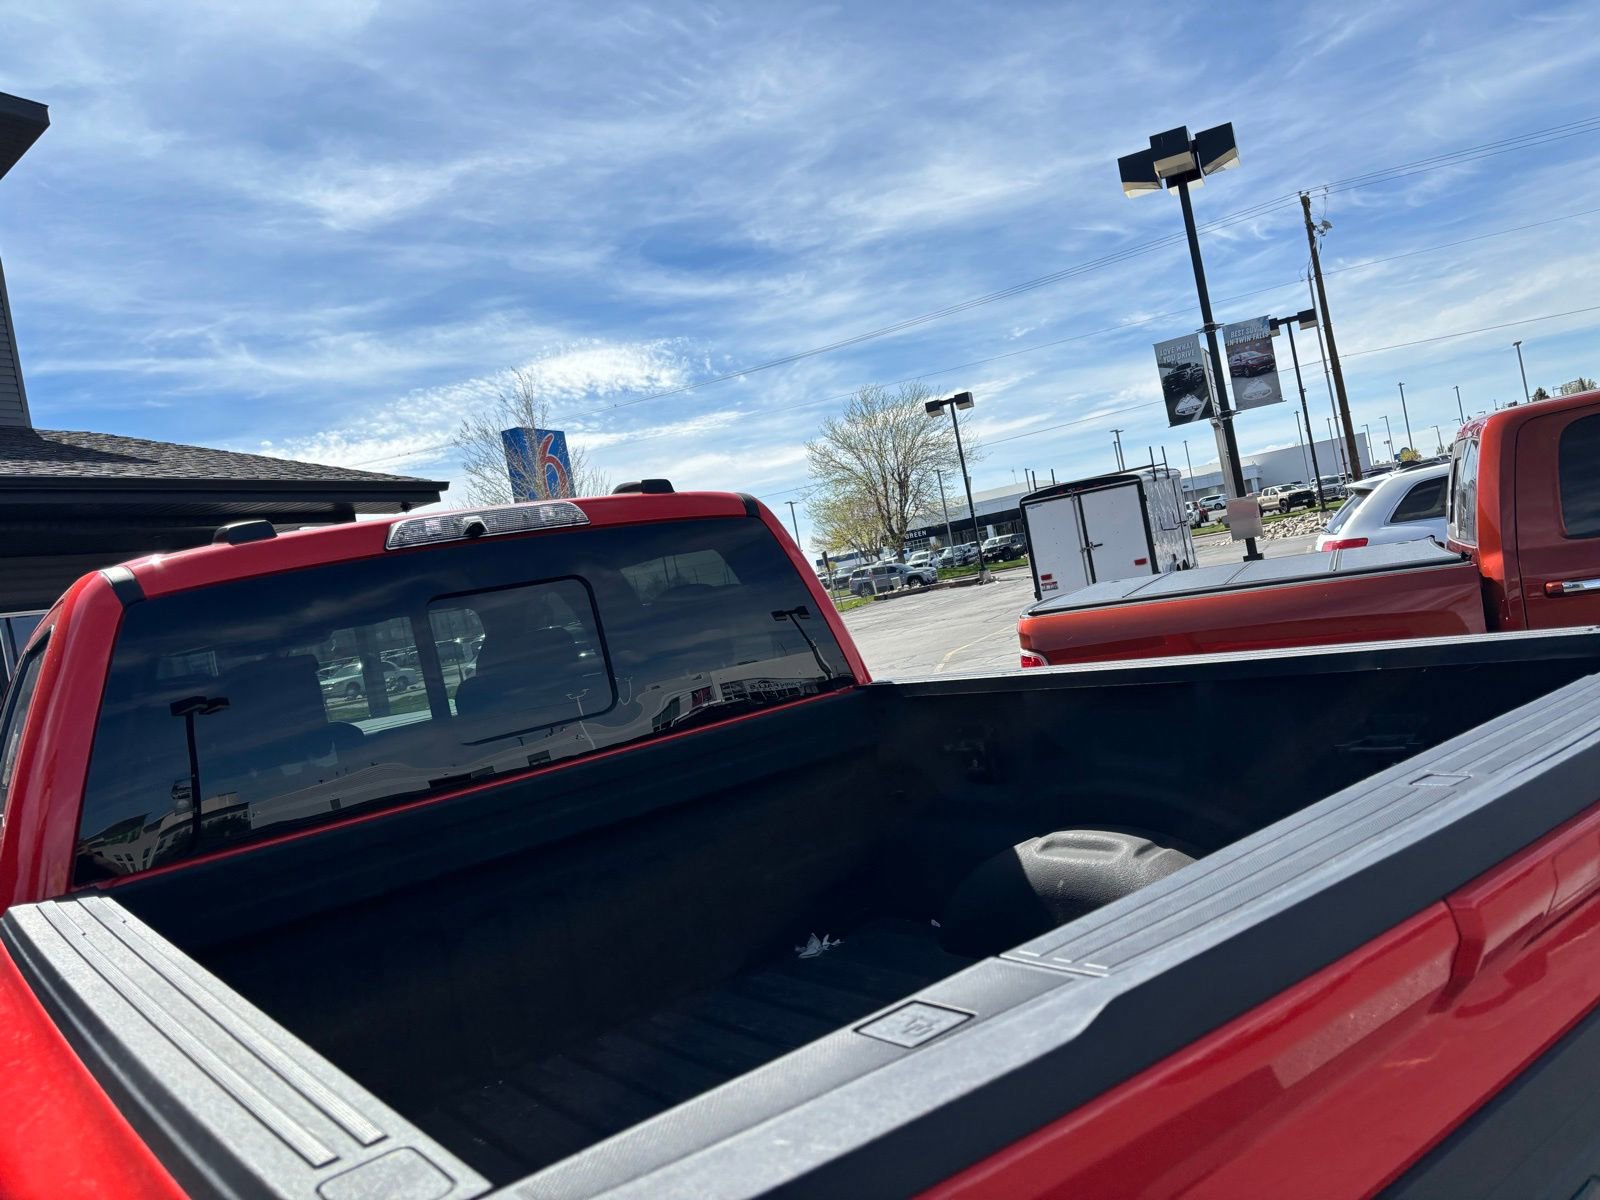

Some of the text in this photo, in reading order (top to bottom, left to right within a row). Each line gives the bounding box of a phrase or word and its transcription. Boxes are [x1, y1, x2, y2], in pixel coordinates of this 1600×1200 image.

[1227, 330, 1269, 347] IN TWIN FALLS
[1230, 328, 1244, 339] BEST
[1159, 341, 1194, 357] LOVE WHAT
[1163, 349, 1195, 364] YOU DRIVE
[535, 432, 570, 500] 6
